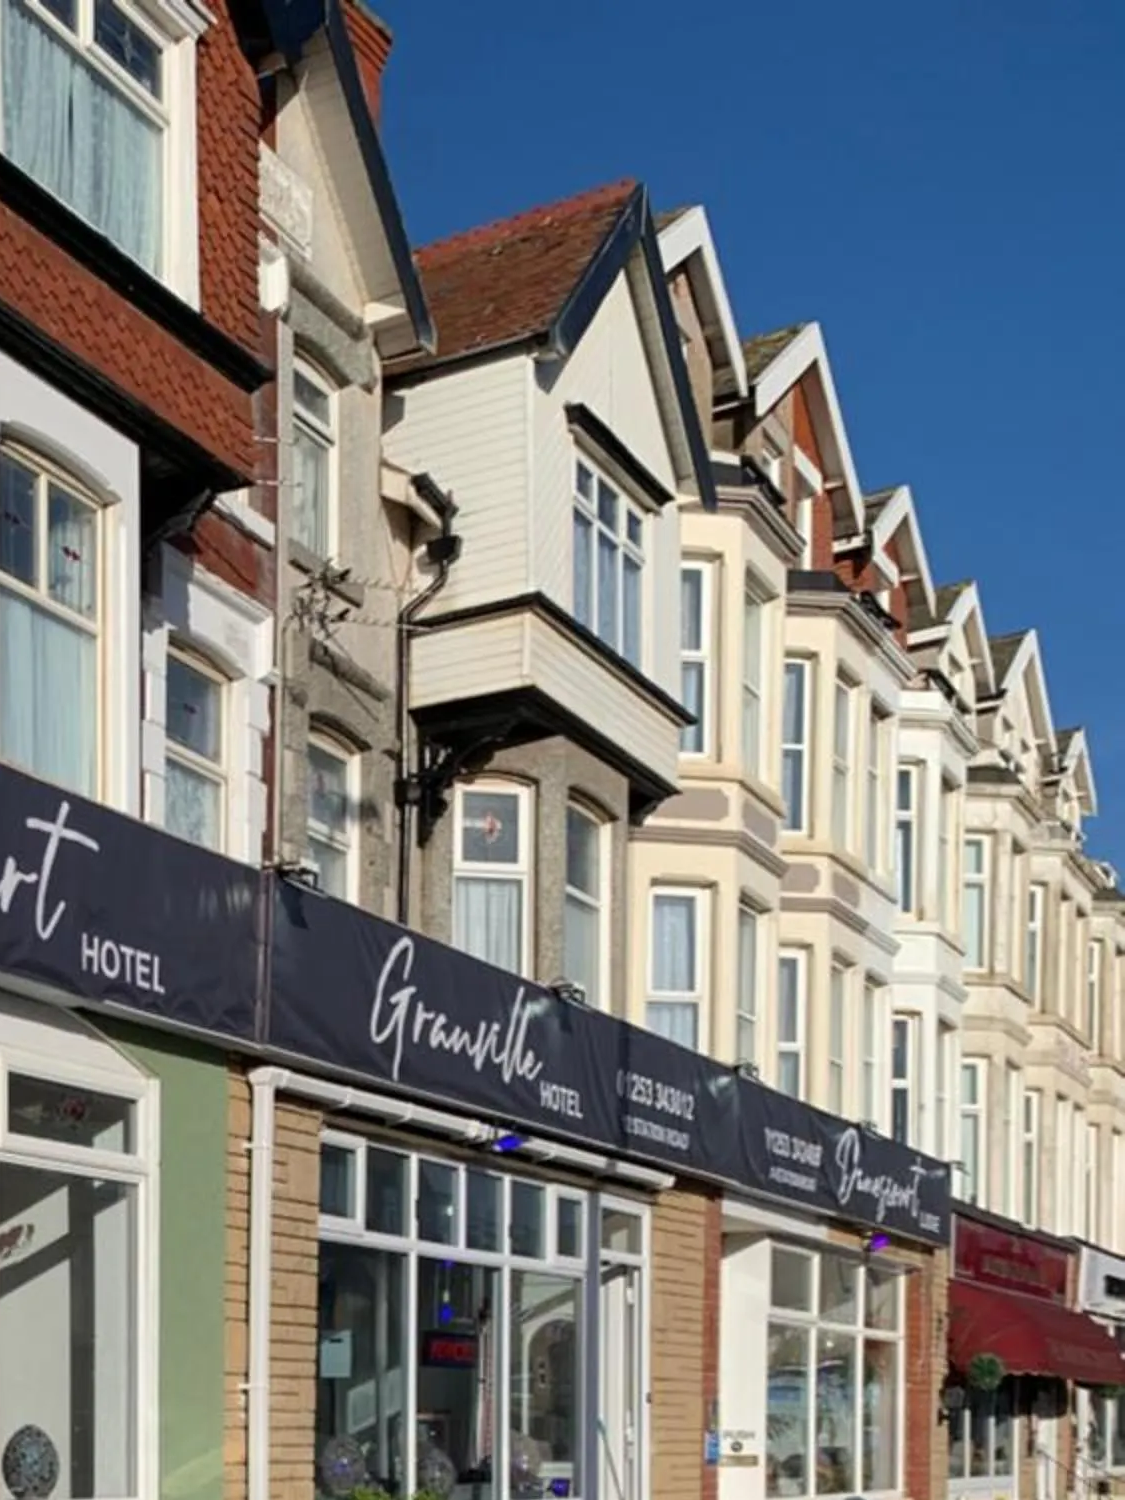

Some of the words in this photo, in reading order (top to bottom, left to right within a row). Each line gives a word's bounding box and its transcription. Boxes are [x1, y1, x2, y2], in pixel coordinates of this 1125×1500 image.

[80, 935, 165, 994] HOTEL
[370, 936, 543, 1084] Granville
[540, 1080, 583, 1119] HOTEL
